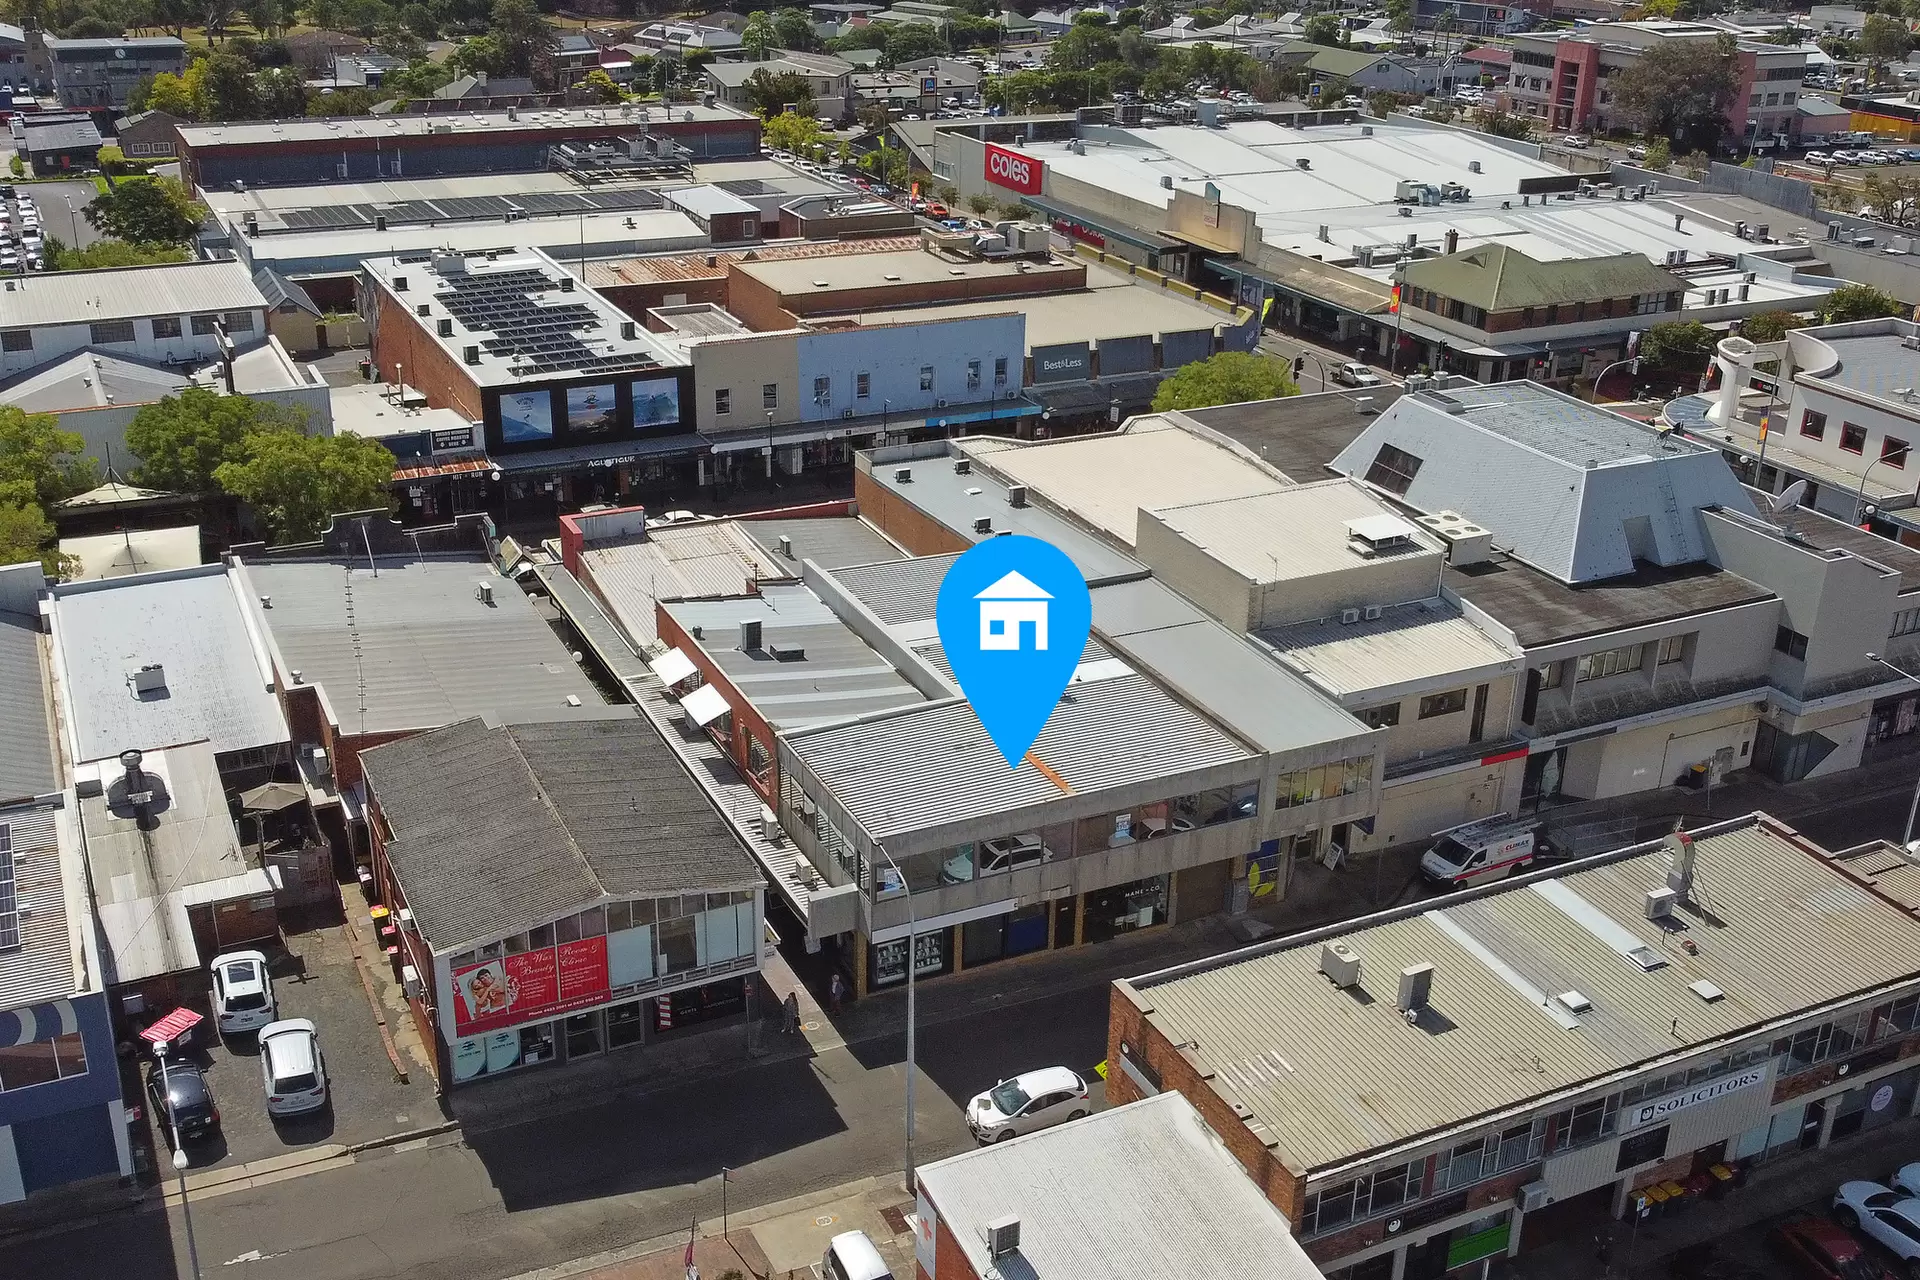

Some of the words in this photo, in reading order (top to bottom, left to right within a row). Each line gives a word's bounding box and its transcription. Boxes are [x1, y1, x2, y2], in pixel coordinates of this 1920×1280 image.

[990, 152, 1029, 185] coles
[587, 455, 635, 468] AQUTIQUE
[1656, 1071, 1760, 1115] SOLICITORS
